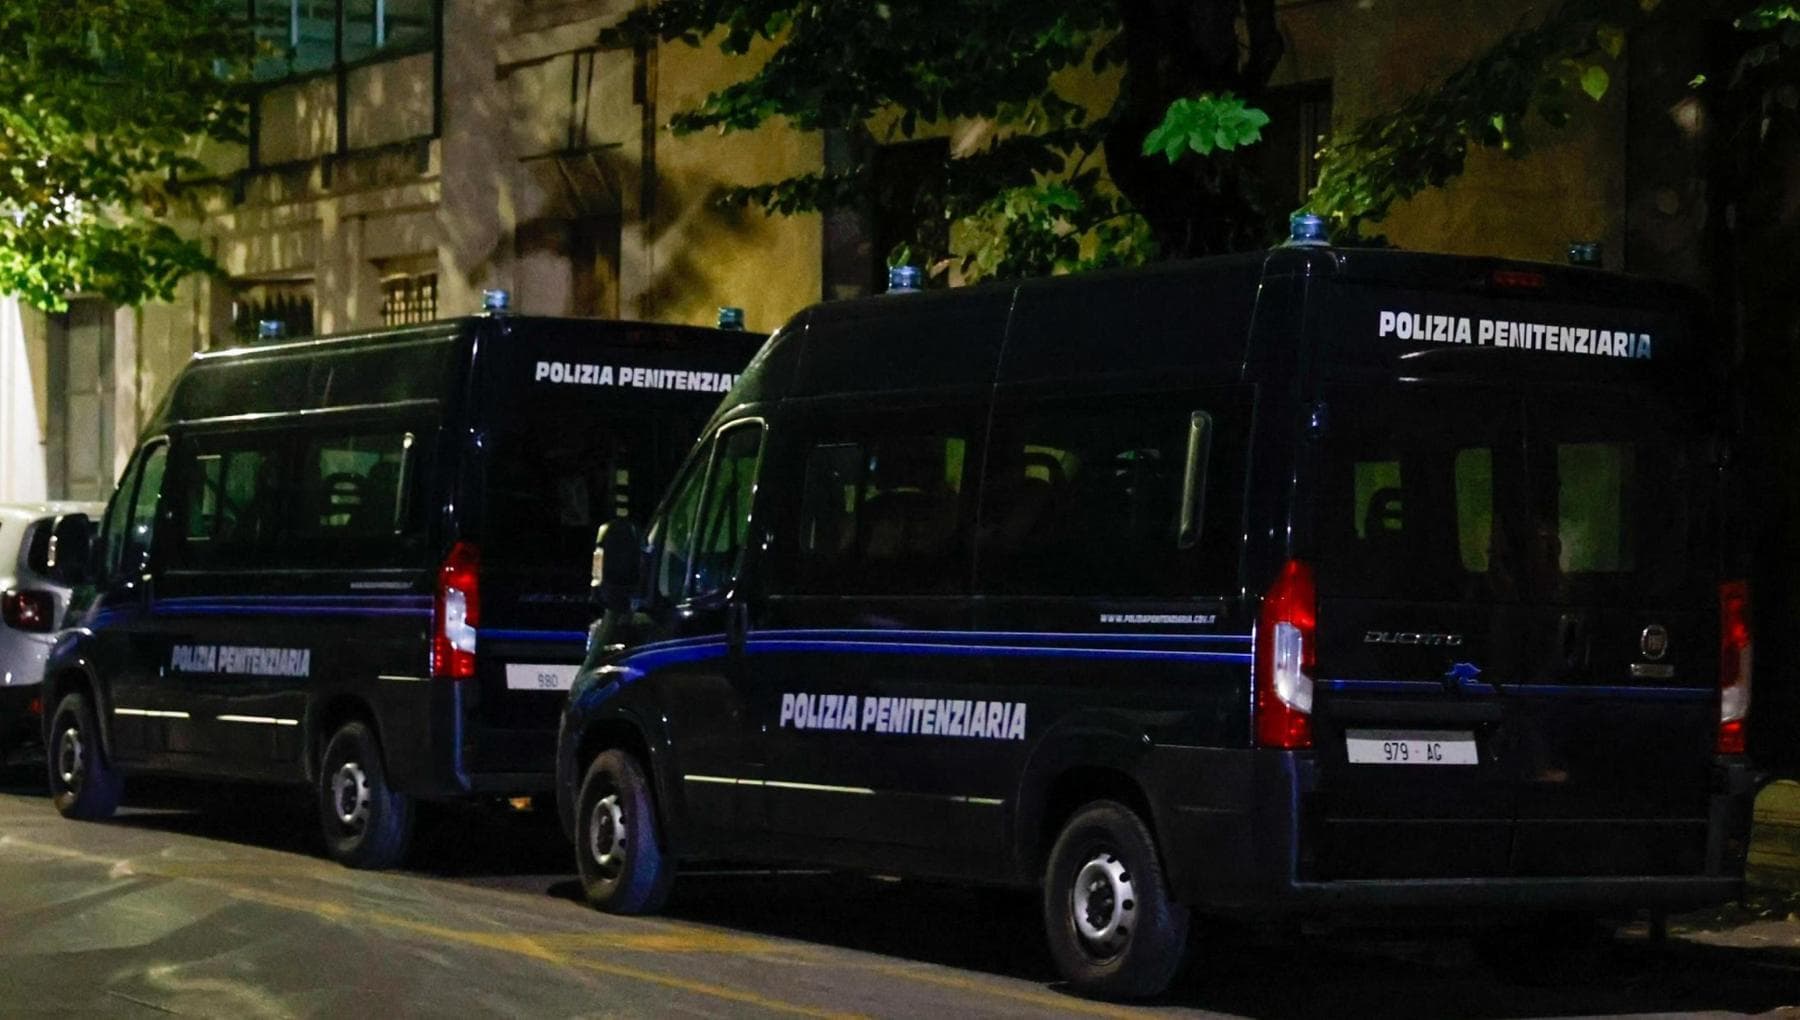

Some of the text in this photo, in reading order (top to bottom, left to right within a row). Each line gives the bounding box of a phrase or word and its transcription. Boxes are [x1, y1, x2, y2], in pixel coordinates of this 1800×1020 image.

[1378, 310, 1653, 360] POLIZIA PENITENZIARIA
[535, 360, 741, 393] POLIZIA PENITENZIA
[170, 644, 311, 678] POLIZIA PENITENZIARIA
[779, 692, 1028, 740] POLIZIA PENITENZIARIA
[1384, 742, 1409, 761] 979
